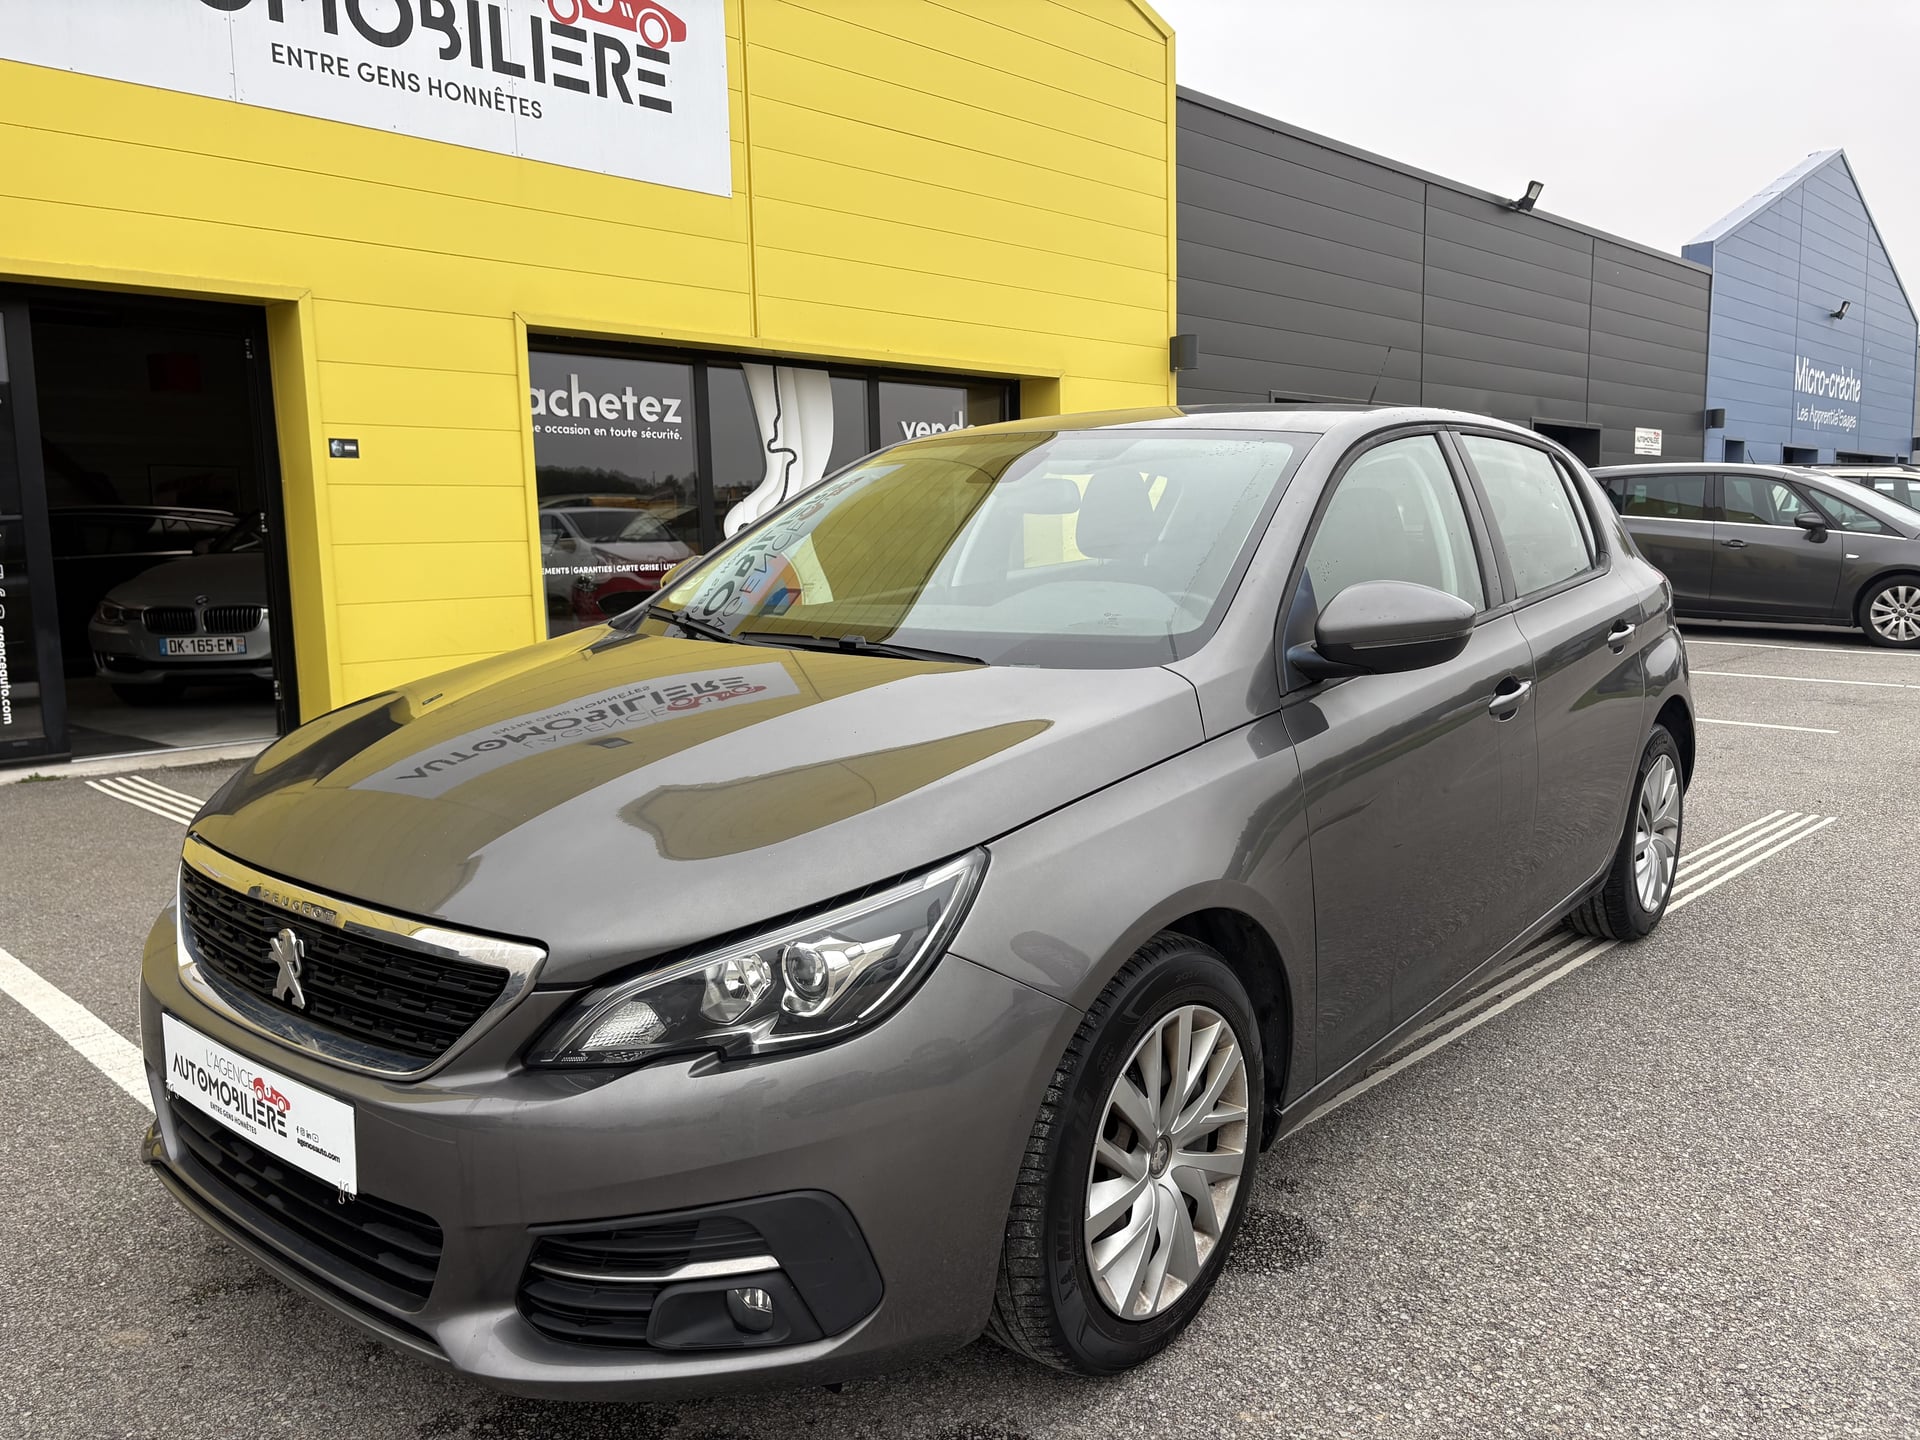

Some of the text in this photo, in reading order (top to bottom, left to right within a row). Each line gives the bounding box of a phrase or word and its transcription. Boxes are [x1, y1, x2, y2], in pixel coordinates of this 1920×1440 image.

[271, 42, 543, 119] ENTRE GENS HONNÊTES
[1794, 354, 1861, 402] Micro-crèche
[531, 373, 682, 423] achetez
[1797, 401, 1809, 421] Les
[544, 423, 591, 435] occasion
[594, 427, 607, 437] en
[610, 426, 638, 438] toute
[641, 427, 683, 440] sécurité.
[900, 410, 976, 440] vend
[573, 565, 613, 574] GARANTIES
[616, 564, 639, 572] CARTE
[640, 563, 660, 571] GRISE
[262, 889, 336, 922] PEUGEOT
[205, 1048, 255, 1092] L'AGENCE
[210, 1101, 223, 1115] ENTRE
